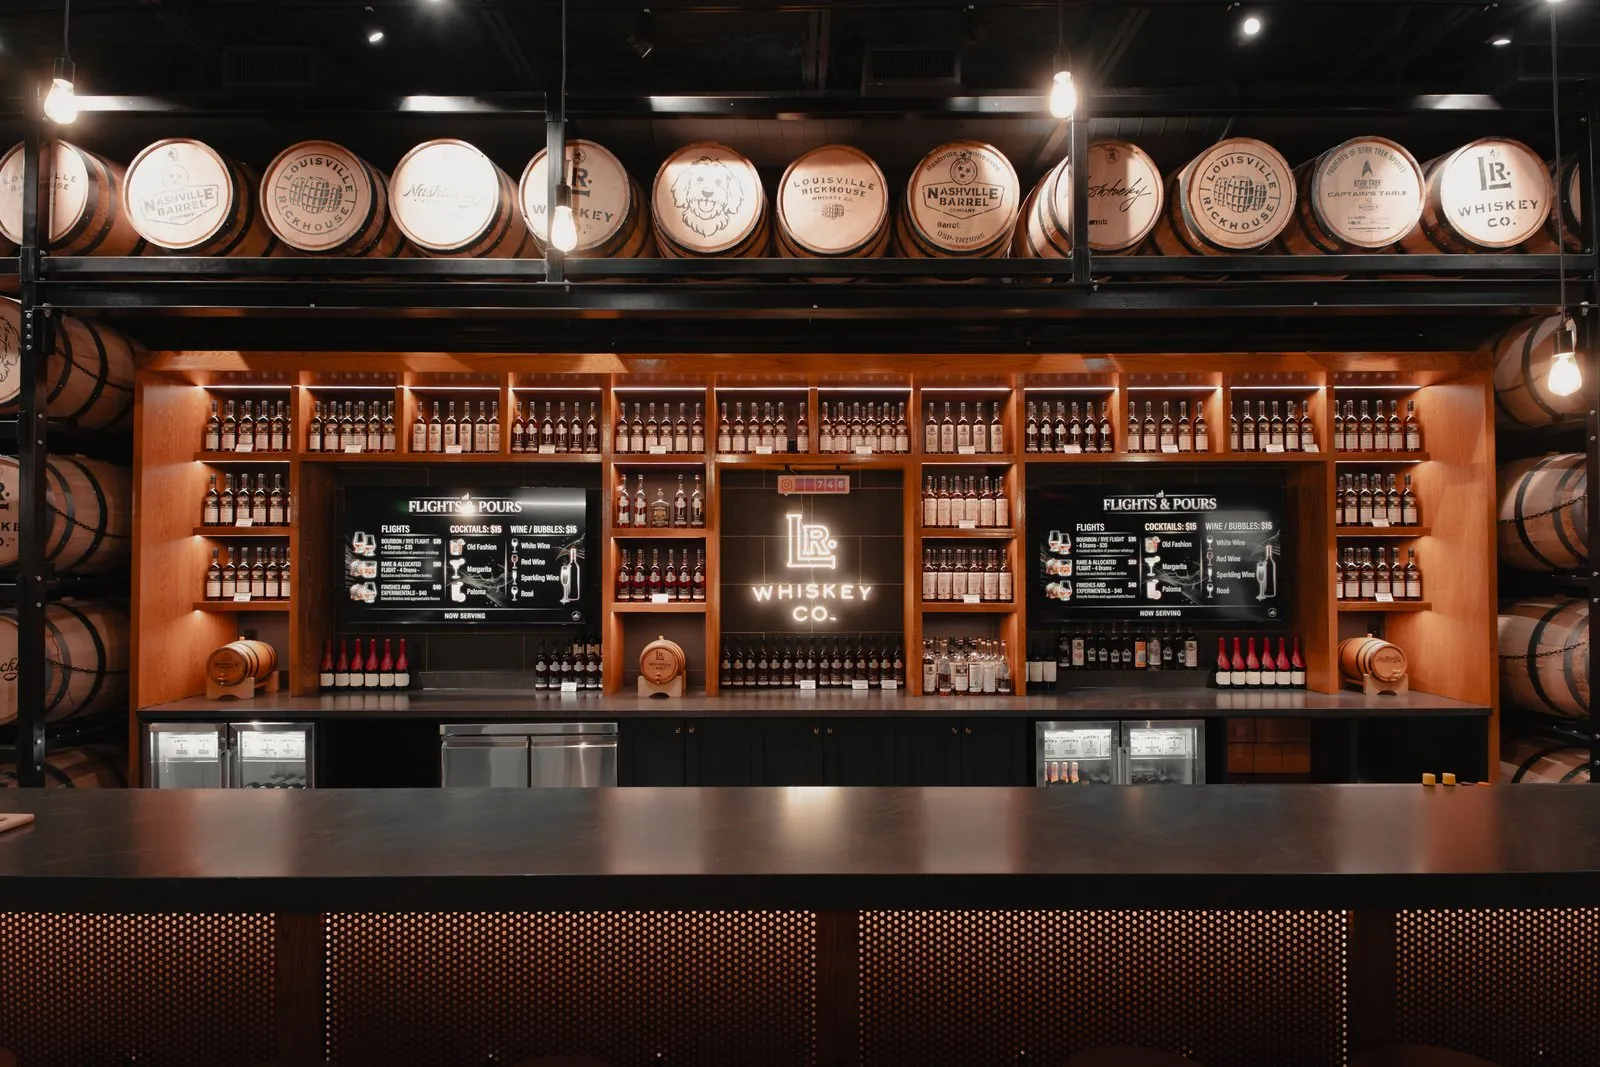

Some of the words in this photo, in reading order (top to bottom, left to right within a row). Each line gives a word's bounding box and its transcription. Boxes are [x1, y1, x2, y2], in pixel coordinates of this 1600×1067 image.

[1326, 153, 1349, 177] PROPERTY
[1357, 146, 1373, 155] STAR
[1374, 147, 1389, 158] TREK
[284, 157, 353, 192] LOUISVILLE
[1206, 156, 1277, 190] LOUISVILLE
[793, 177, 876, 191] LOUISVILLE
[802, 186, 866, 197] RICKHOUSE
[927, 187, 999, 200] NASHVILLE
[1327, 190, 1376, 198] CAPTAIN'S
[144, 188, 214, 212] NASHVILLE
[939, 197, 989, 207] BARREL
[158, 200, 206, 216] BARREL
[278, 195, 349, 231] RICKHOUSE
[532, 204, 613, 222] WKEY
[1203, 196, 1274, 230] RICKHOUSE
[1457, 200, 1539, 217] WHISKEY
[1487, 216, 1517, 228] CO.
[408, 500, 462, 513] FLIGHTS
[478, 500, 523, 513] POURS
[1103, 498, 1158, 511] FLIGHTS
[1160, 498, 1170, 510] &
[1173, 497, 1217, 510] POURS
[381, 524, 410, 533] FLIGHTS
[450, 525, 489, 533] COCKTAILS:
[490, 525, 503, 533] $15
[510, 525, 528, 533] WINE
[533, 525, 565, 533] BUBBLES:
[565, 525, 577, 533] $15
[1076, 523, 1105, 531] FLIGHTS
[1144, 522, 1184, 531] COCKTAILS:
[1185, 522, 1197, 531] $15
[1205, 522, 1223, 530] WINE
[1228, 522, 1260, 530] BUBBLES:
[1261, 521, 1273, 530] $15
[467, 565, 492, 573] Margarita
[1162, 563, 1187, 571] Margarita
[521, 574, 546, 582] Sparkling
[1216, 571, 1241, 579] Sparkling
[751, 583, 872, 602] WHISKEY
[792, 605, 837, 622] CO.
